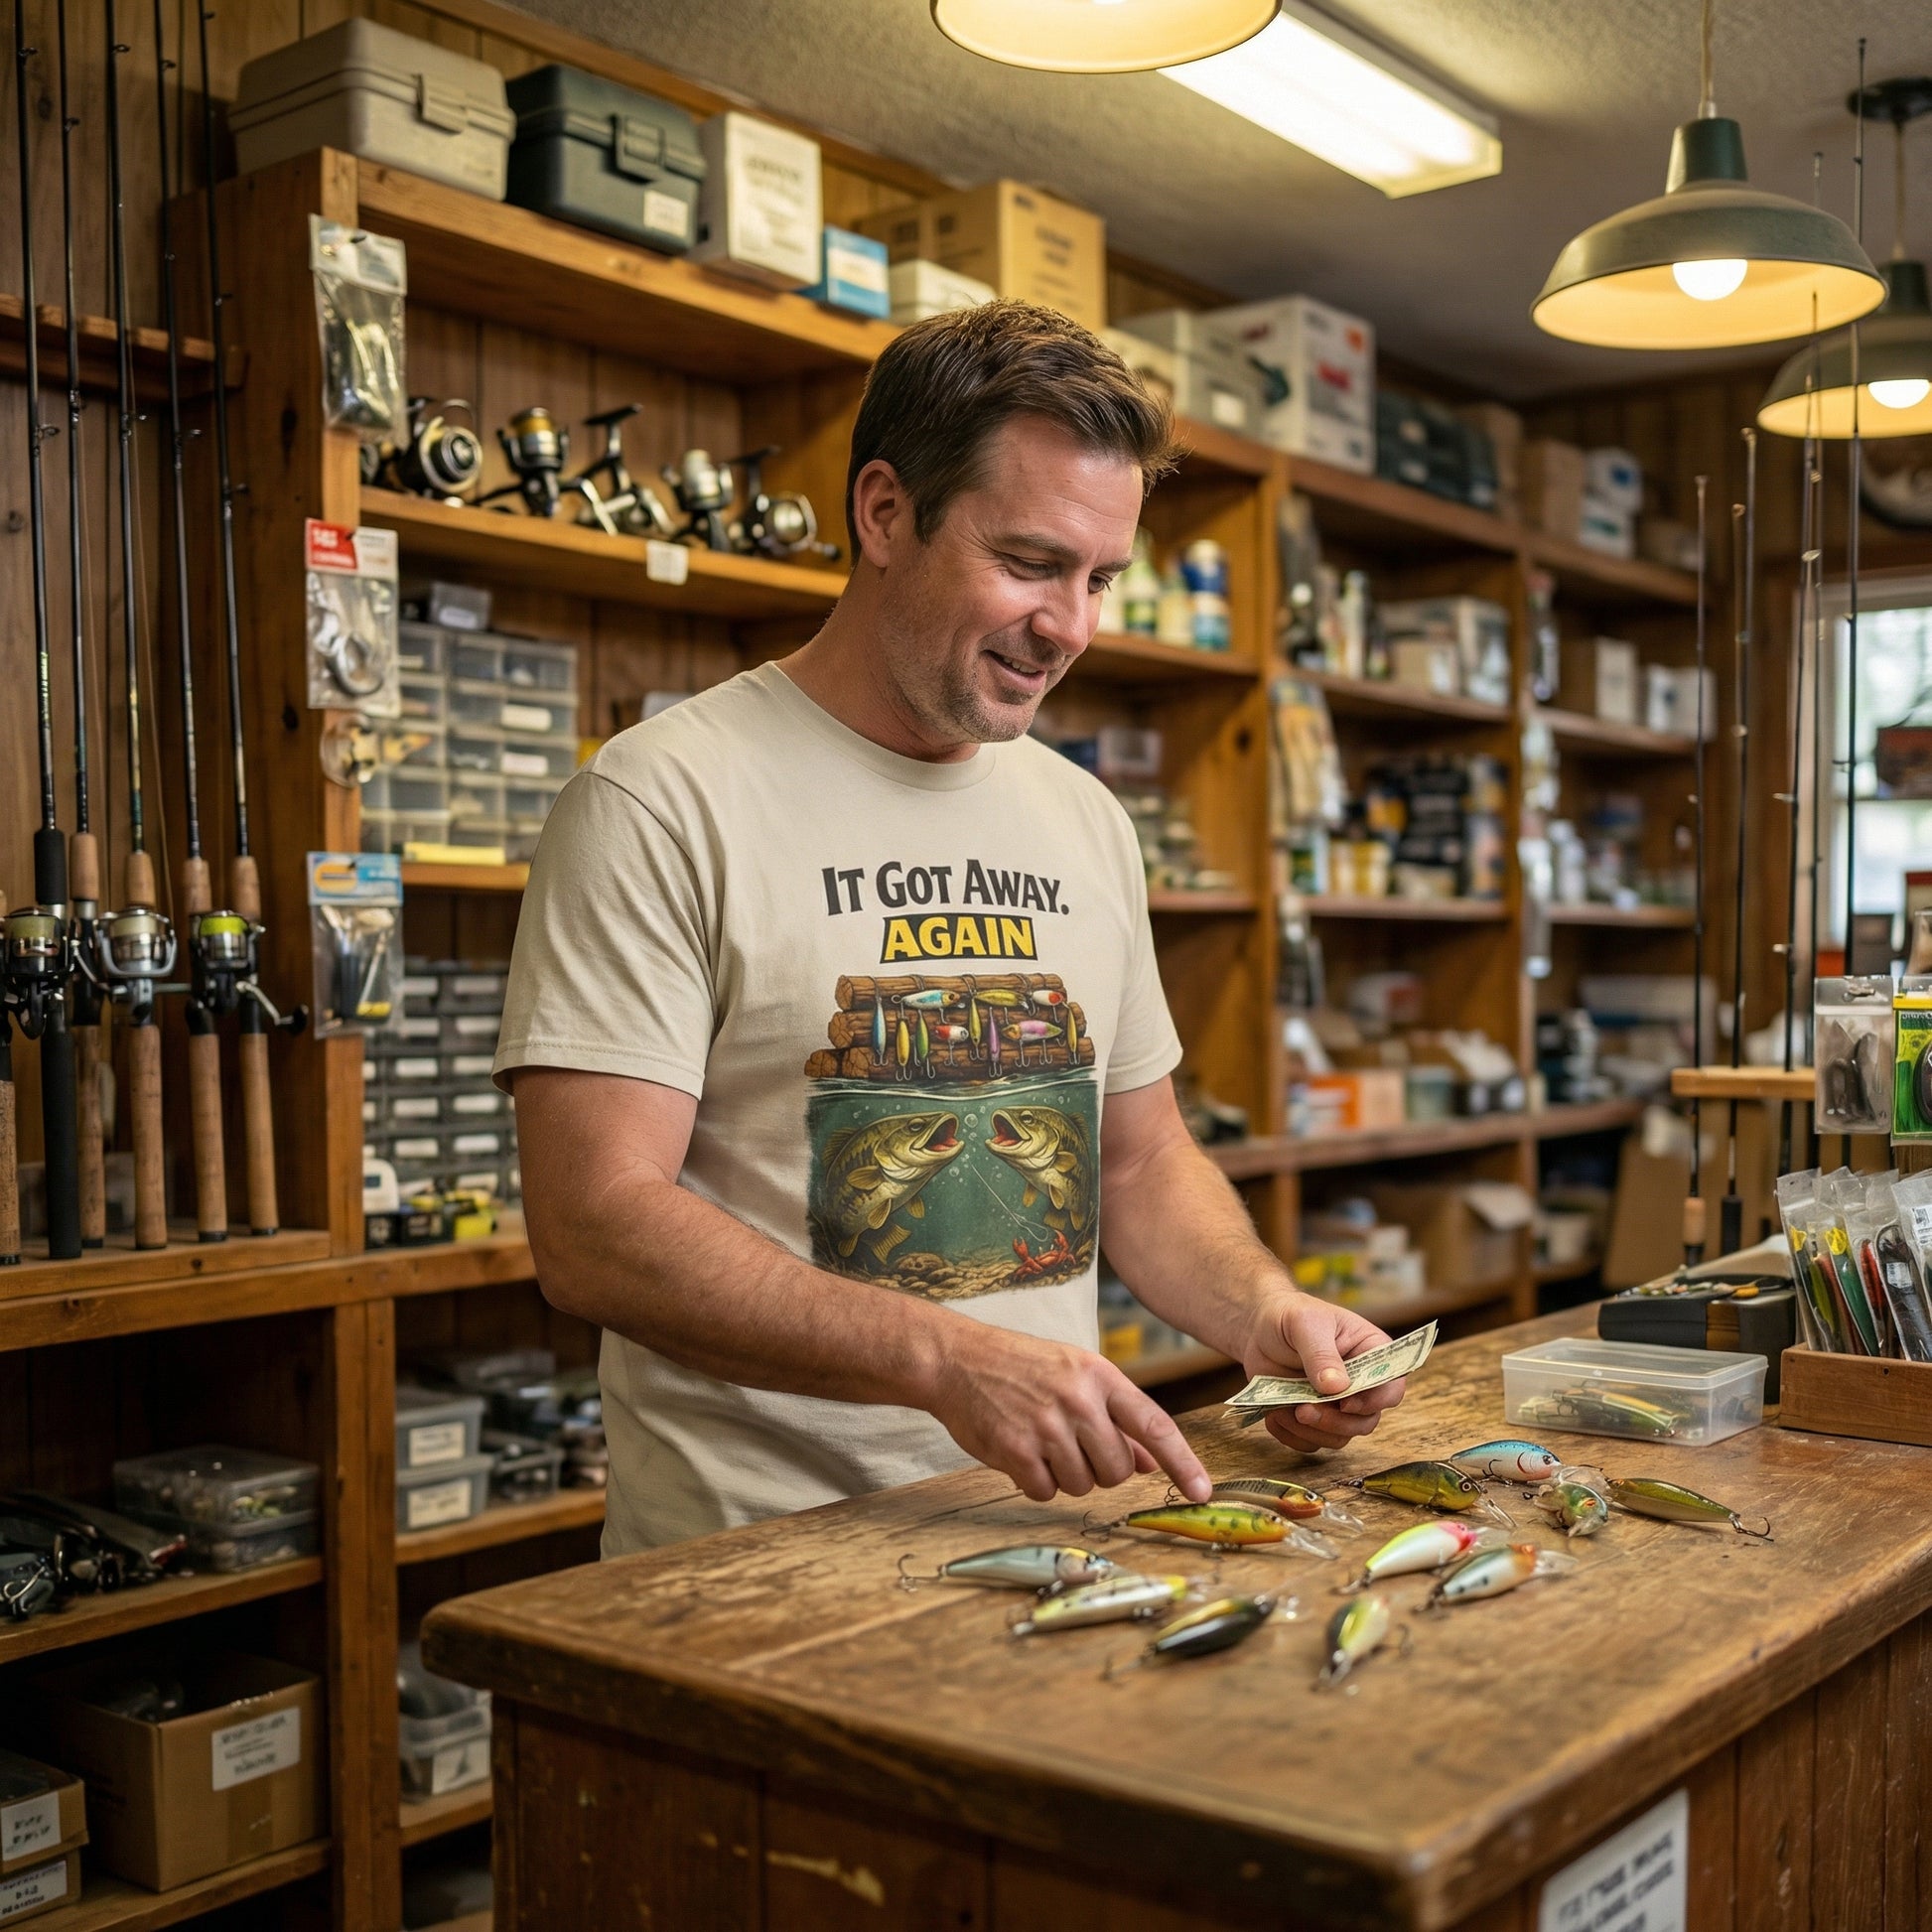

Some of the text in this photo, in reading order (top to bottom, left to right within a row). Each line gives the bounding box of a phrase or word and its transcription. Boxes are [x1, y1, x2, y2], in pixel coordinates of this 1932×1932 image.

[822, 859, 1069, 915] IT GOT AWAY.
[884, 916, 1035, 961] AGAIN
